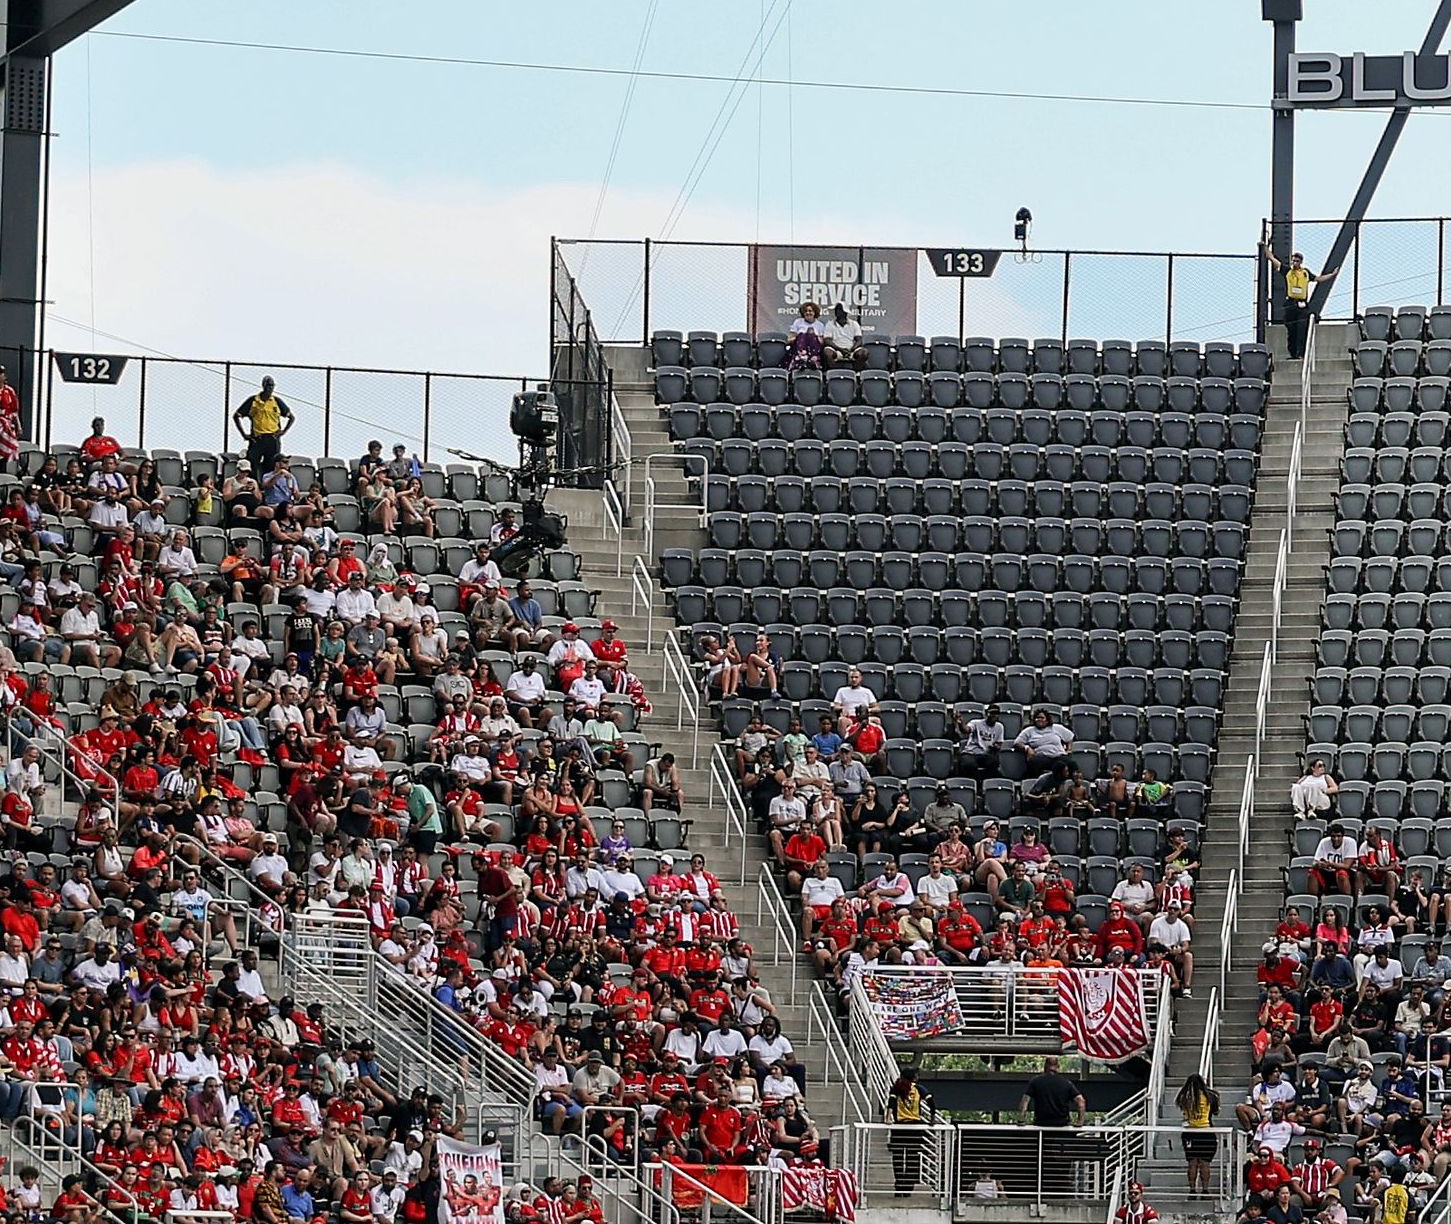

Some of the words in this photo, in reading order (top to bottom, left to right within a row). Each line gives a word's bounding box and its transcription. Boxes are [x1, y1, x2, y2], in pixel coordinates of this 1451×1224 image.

[776, 260, 858, 283] UNITED
[864, 262, 889, 284] IN
[943, 252, 984, 273] 133
[784, 282, 880, 306] SERVICE
[71, 358, 110, 379] 132
